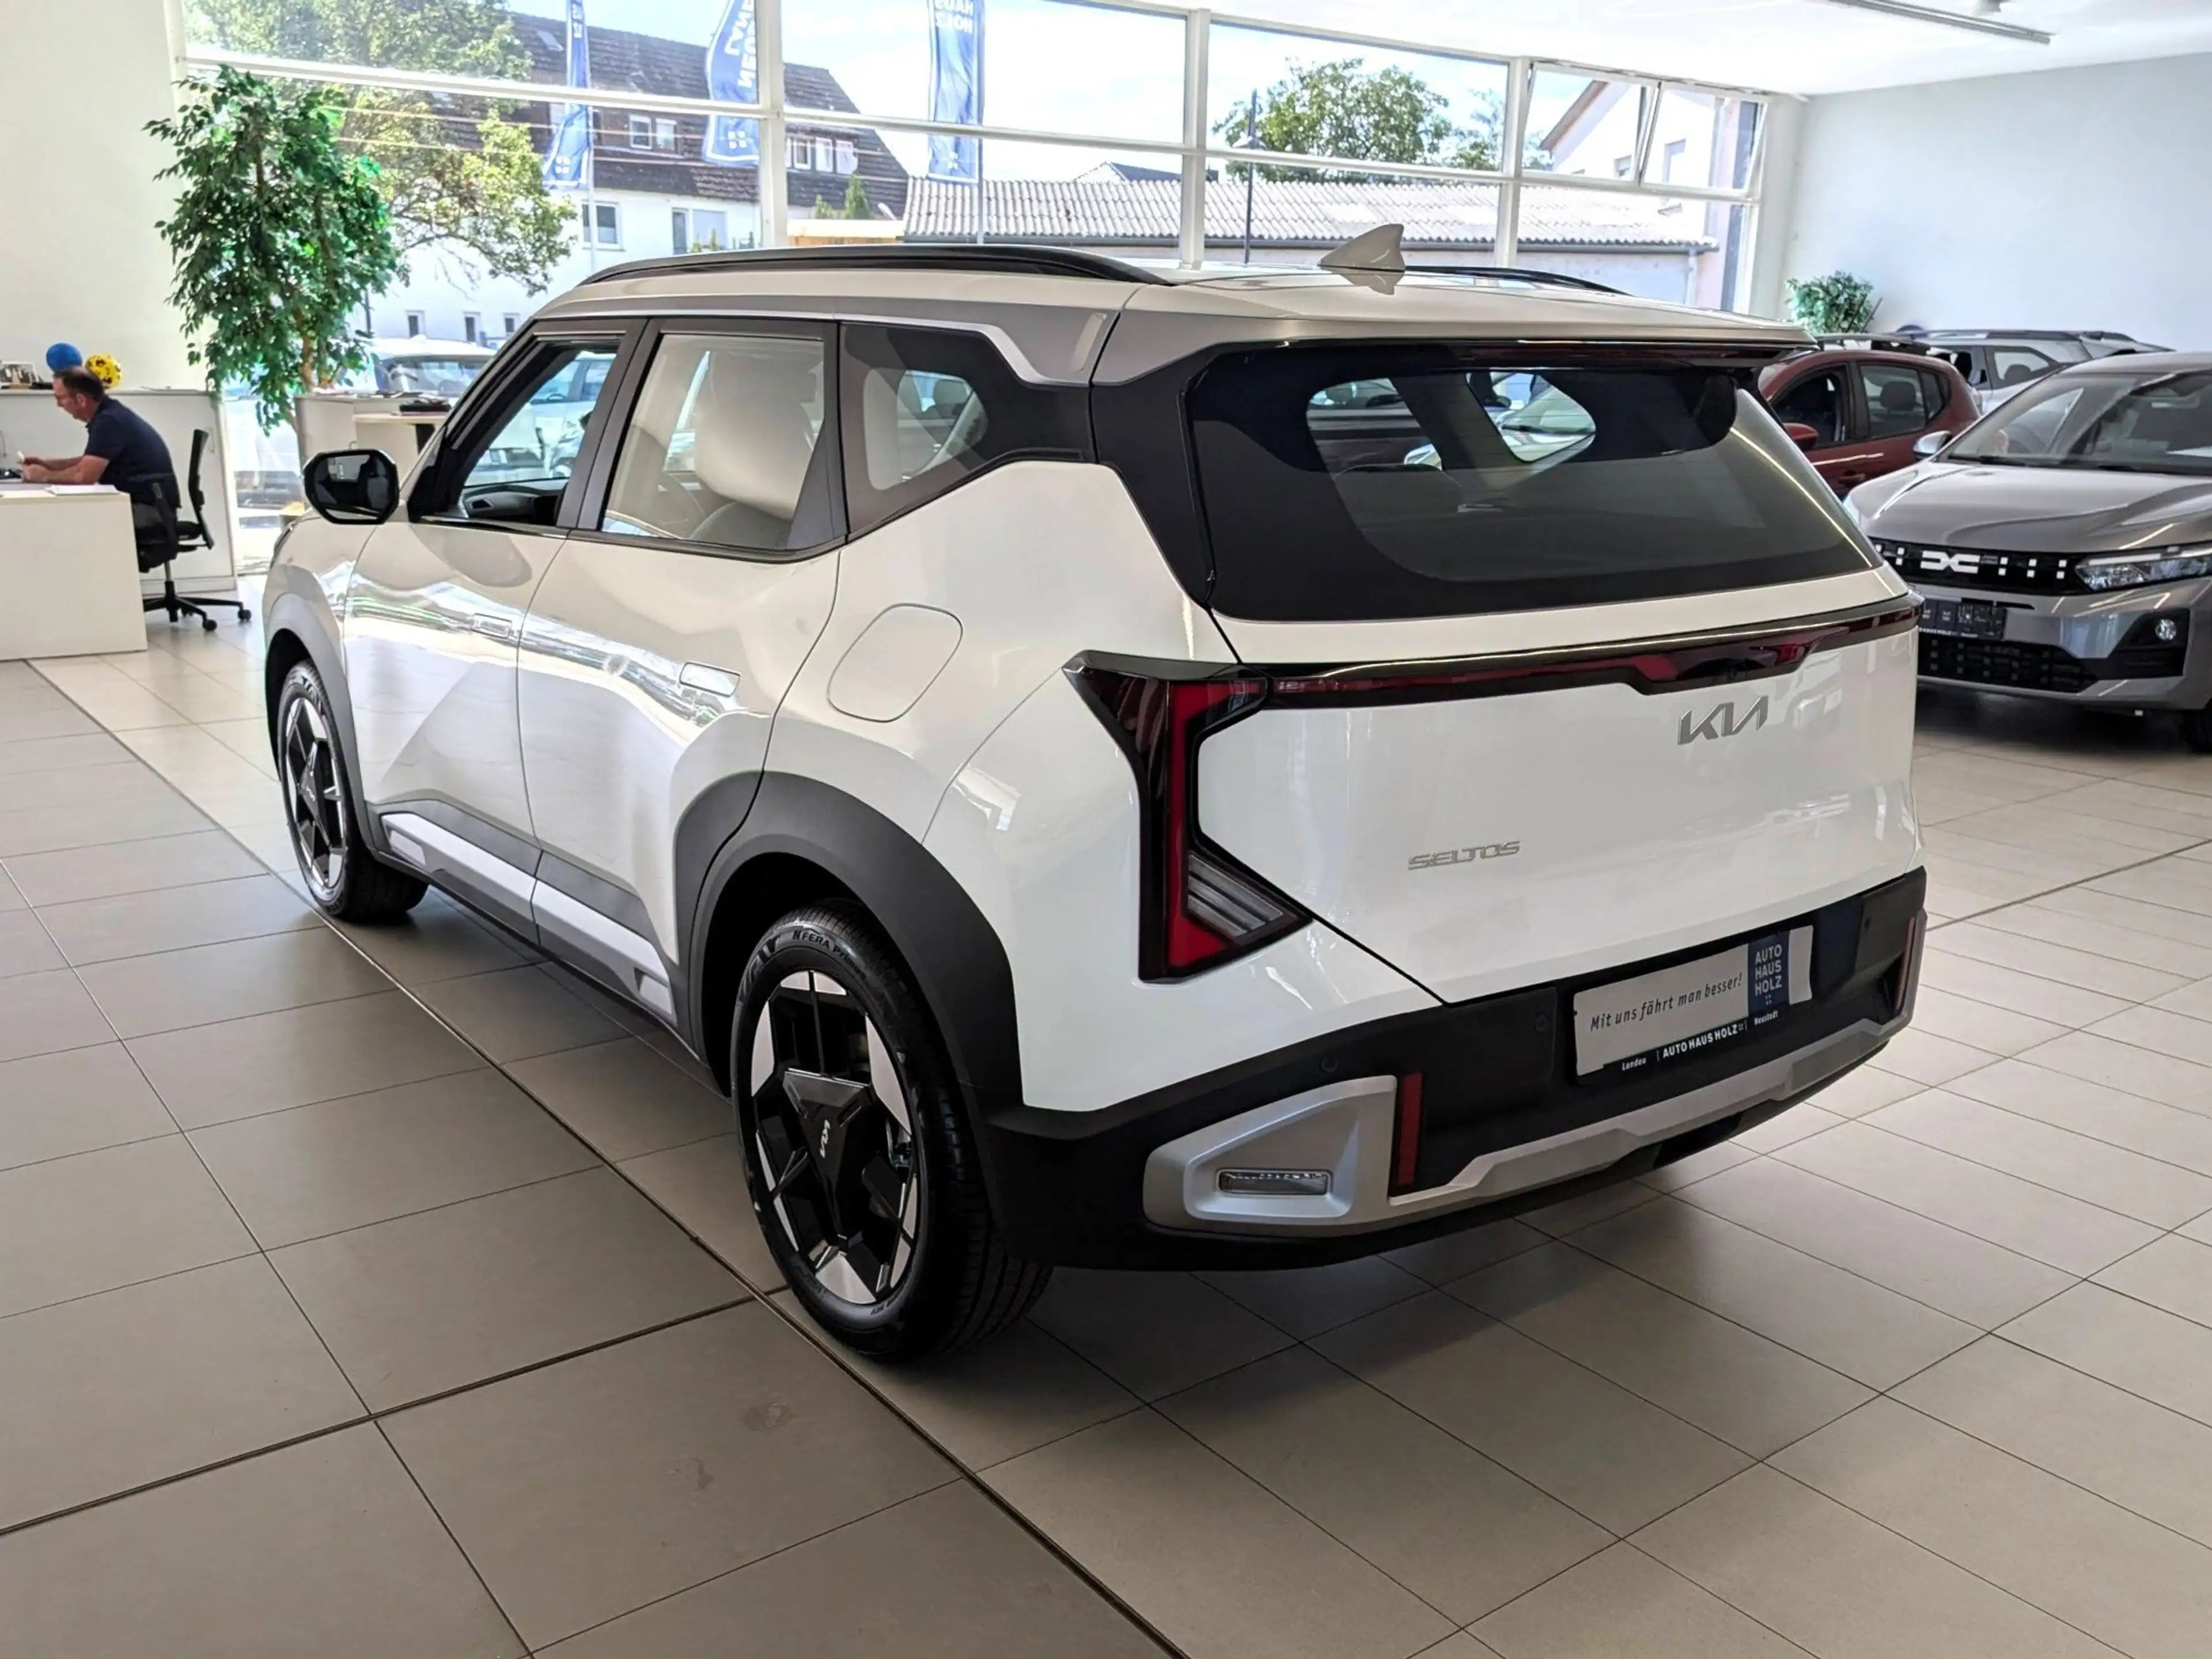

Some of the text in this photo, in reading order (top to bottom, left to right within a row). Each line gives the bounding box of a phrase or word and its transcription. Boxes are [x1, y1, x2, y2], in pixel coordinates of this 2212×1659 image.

[1677, 695, 1768, 745] KIA
[1408, 840, 1520, 870] SELTOS
[1755, 944, 1782, 964] AUTO
[1755, 960, 1782, 980] HAUS
[1755, 975, 1782, 996] HOLZ
[1590, 972, 1743, 1031] Mit uns fährt man besser!
[1663, 1041, 1687, 1058] AUTO
[1688, 1032, 1713, 1050] HAUS
[1714, 1024, 1738, 1041] HOLZ
